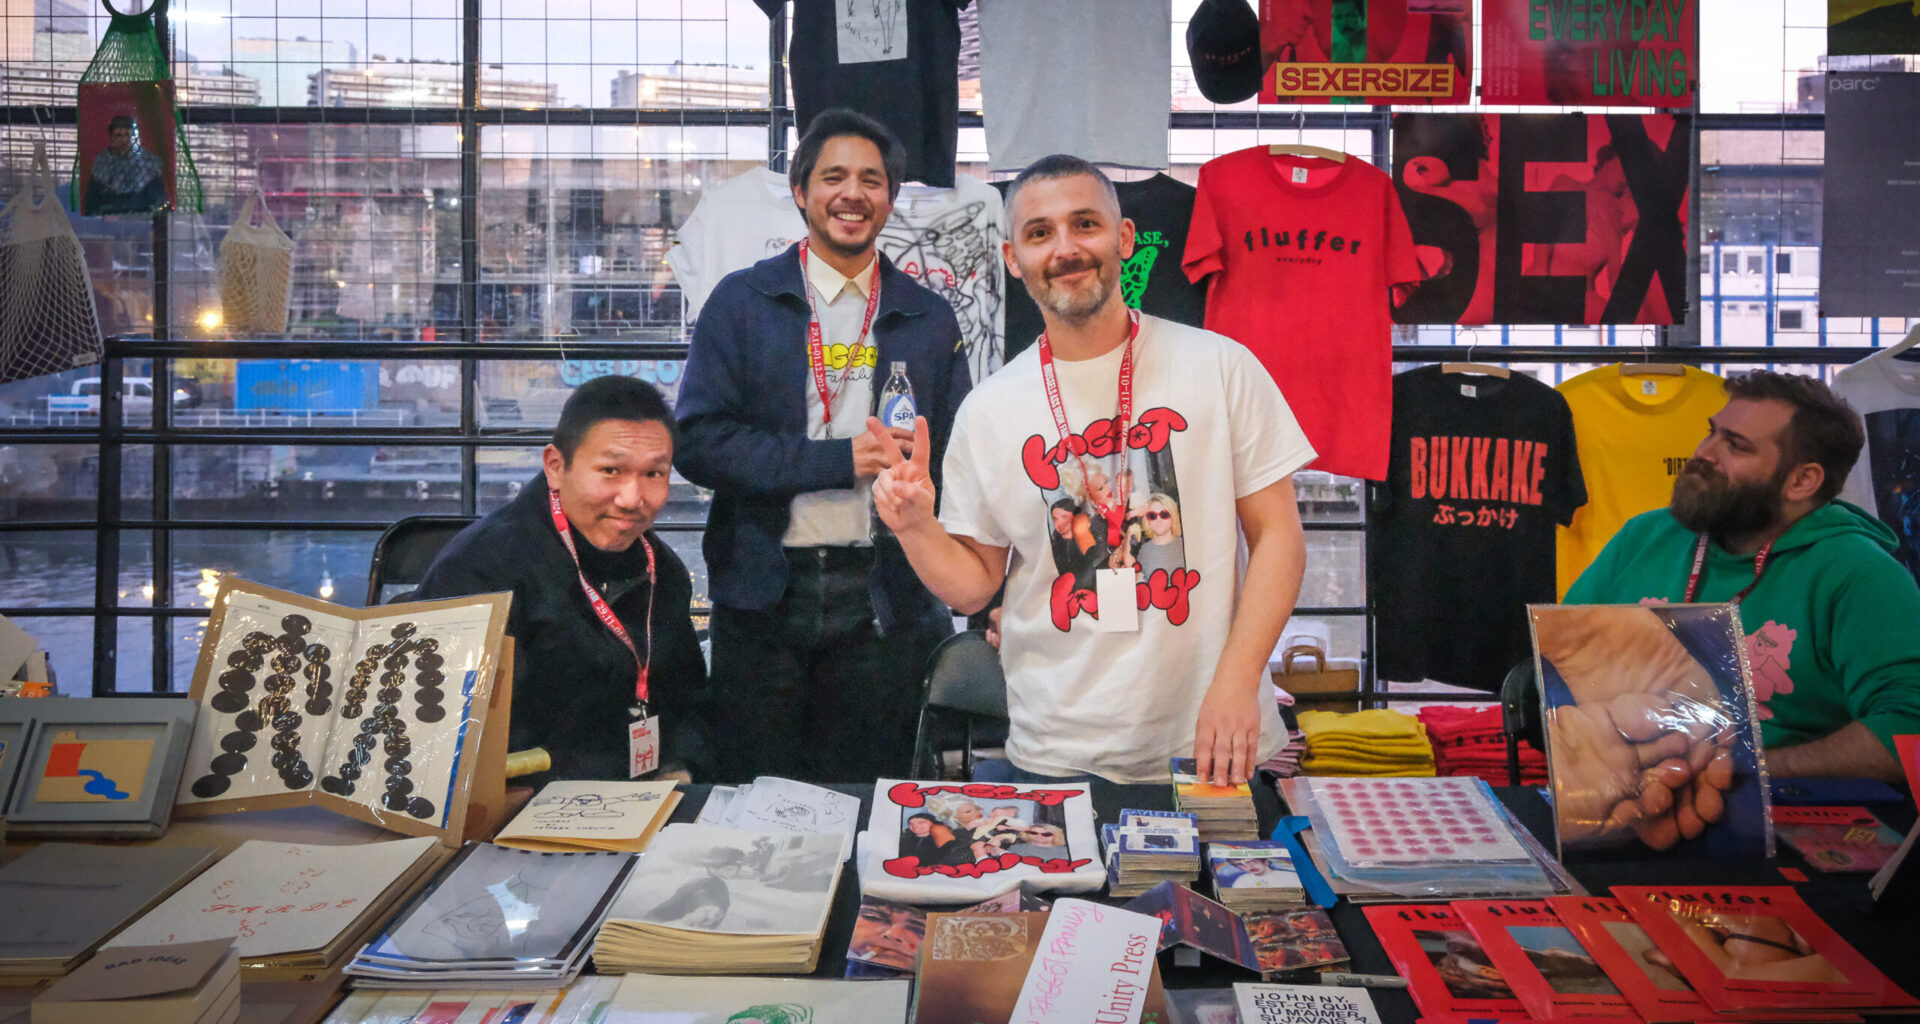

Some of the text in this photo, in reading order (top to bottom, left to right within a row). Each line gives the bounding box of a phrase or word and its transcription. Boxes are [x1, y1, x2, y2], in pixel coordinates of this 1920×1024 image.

[1529, 0, 1686, 42] EVERYDAY
[1280, 67, 1450, 93] SEXERSIZE
[1593, 48, 1687, 97] LIVING
[1391, 113, 1691, 325] SEX
[1244, 227, 1361, 255] fluffer
[894, 411, 916, 421] SPA
[1410, 435, 1548, 506] BUKKAKE
[1433, 503, 1519, 530] ぶっかけ
[1050, 563, 1201, 632] FAILY
[1095, 933, 1149, 1024] Unity Press
[1255, 1000, 1359, 1011] EST-CE QUE
[1258, 1007, 1281, 1016] TU
[1261, 1014, 1276, 1022] SI
